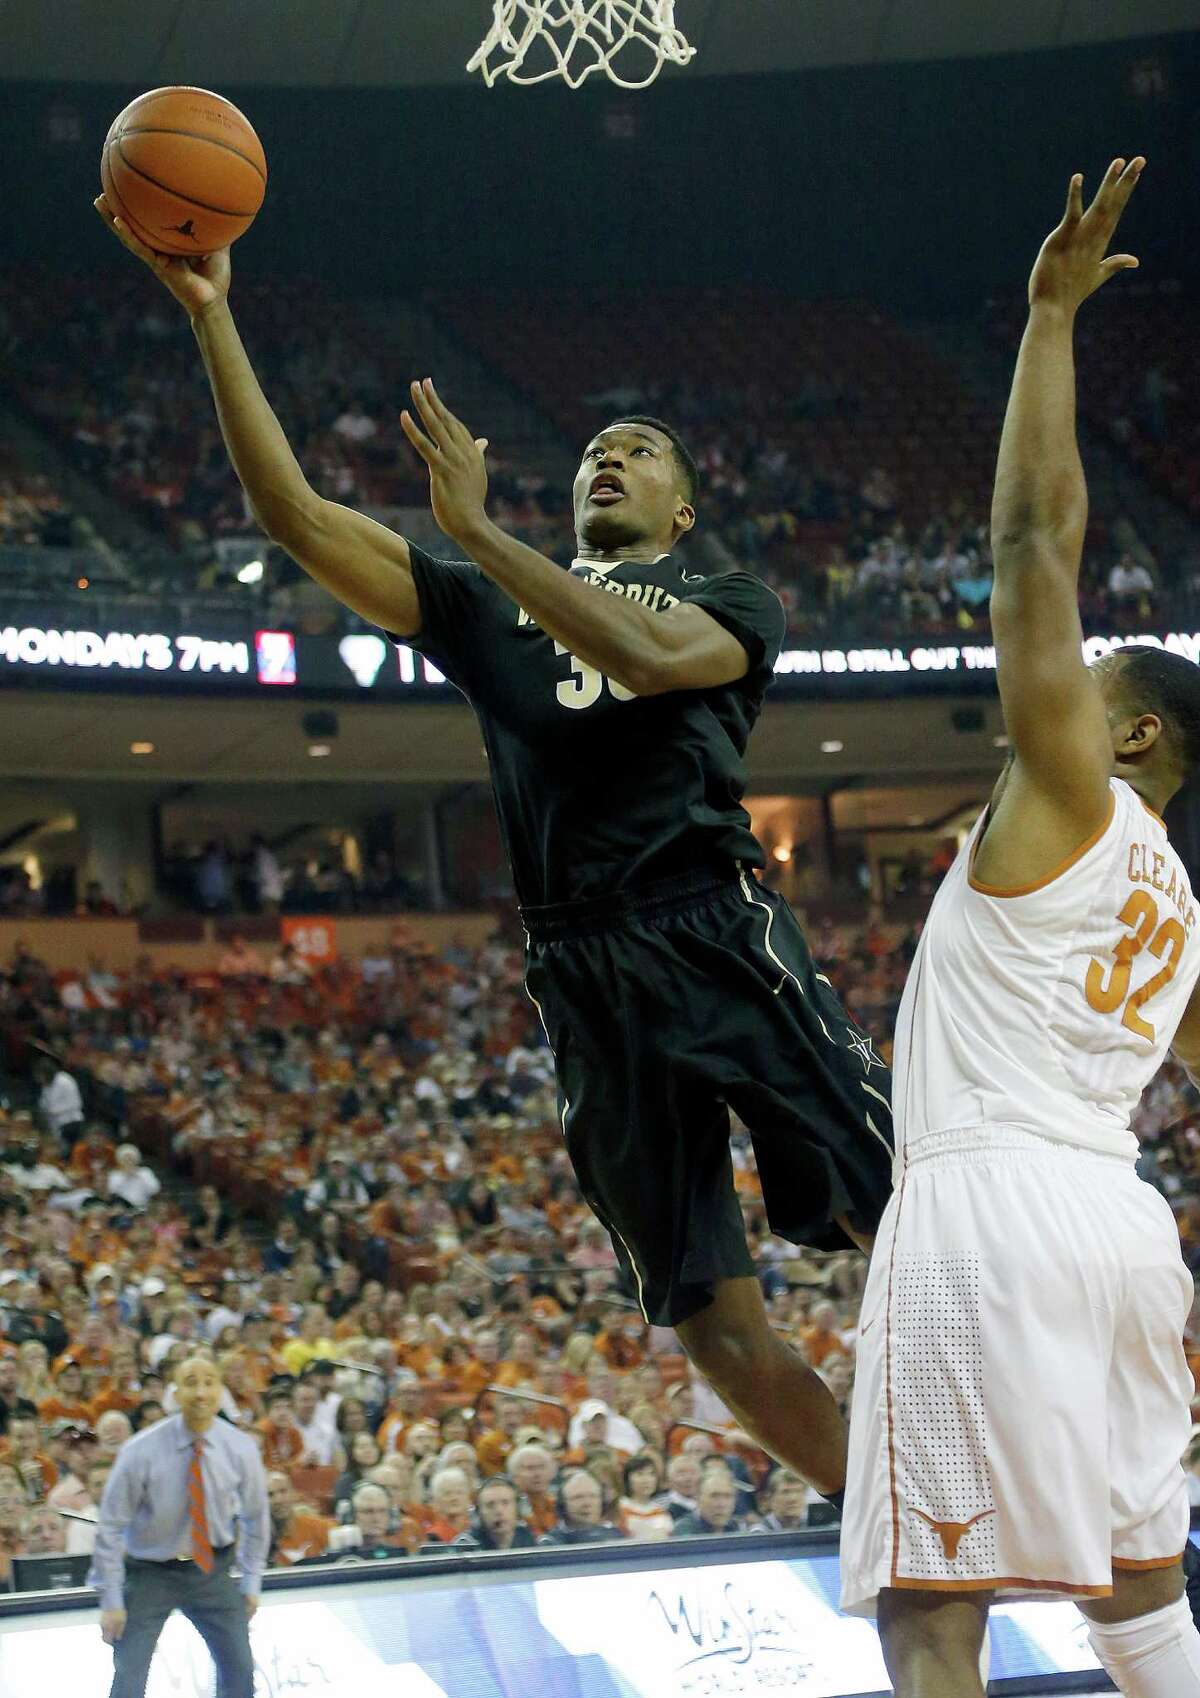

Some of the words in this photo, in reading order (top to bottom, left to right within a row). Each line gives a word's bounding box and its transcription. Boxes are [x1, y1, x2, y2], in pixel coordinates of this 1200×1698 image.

[176, 636, 249, 674] 7PM
[822, 650, 847, 672] IS
[847, 648, 910, 672] STILL
[911, 647, 960, 670] OUT
[1085, 888, 1186, 1044] 32
